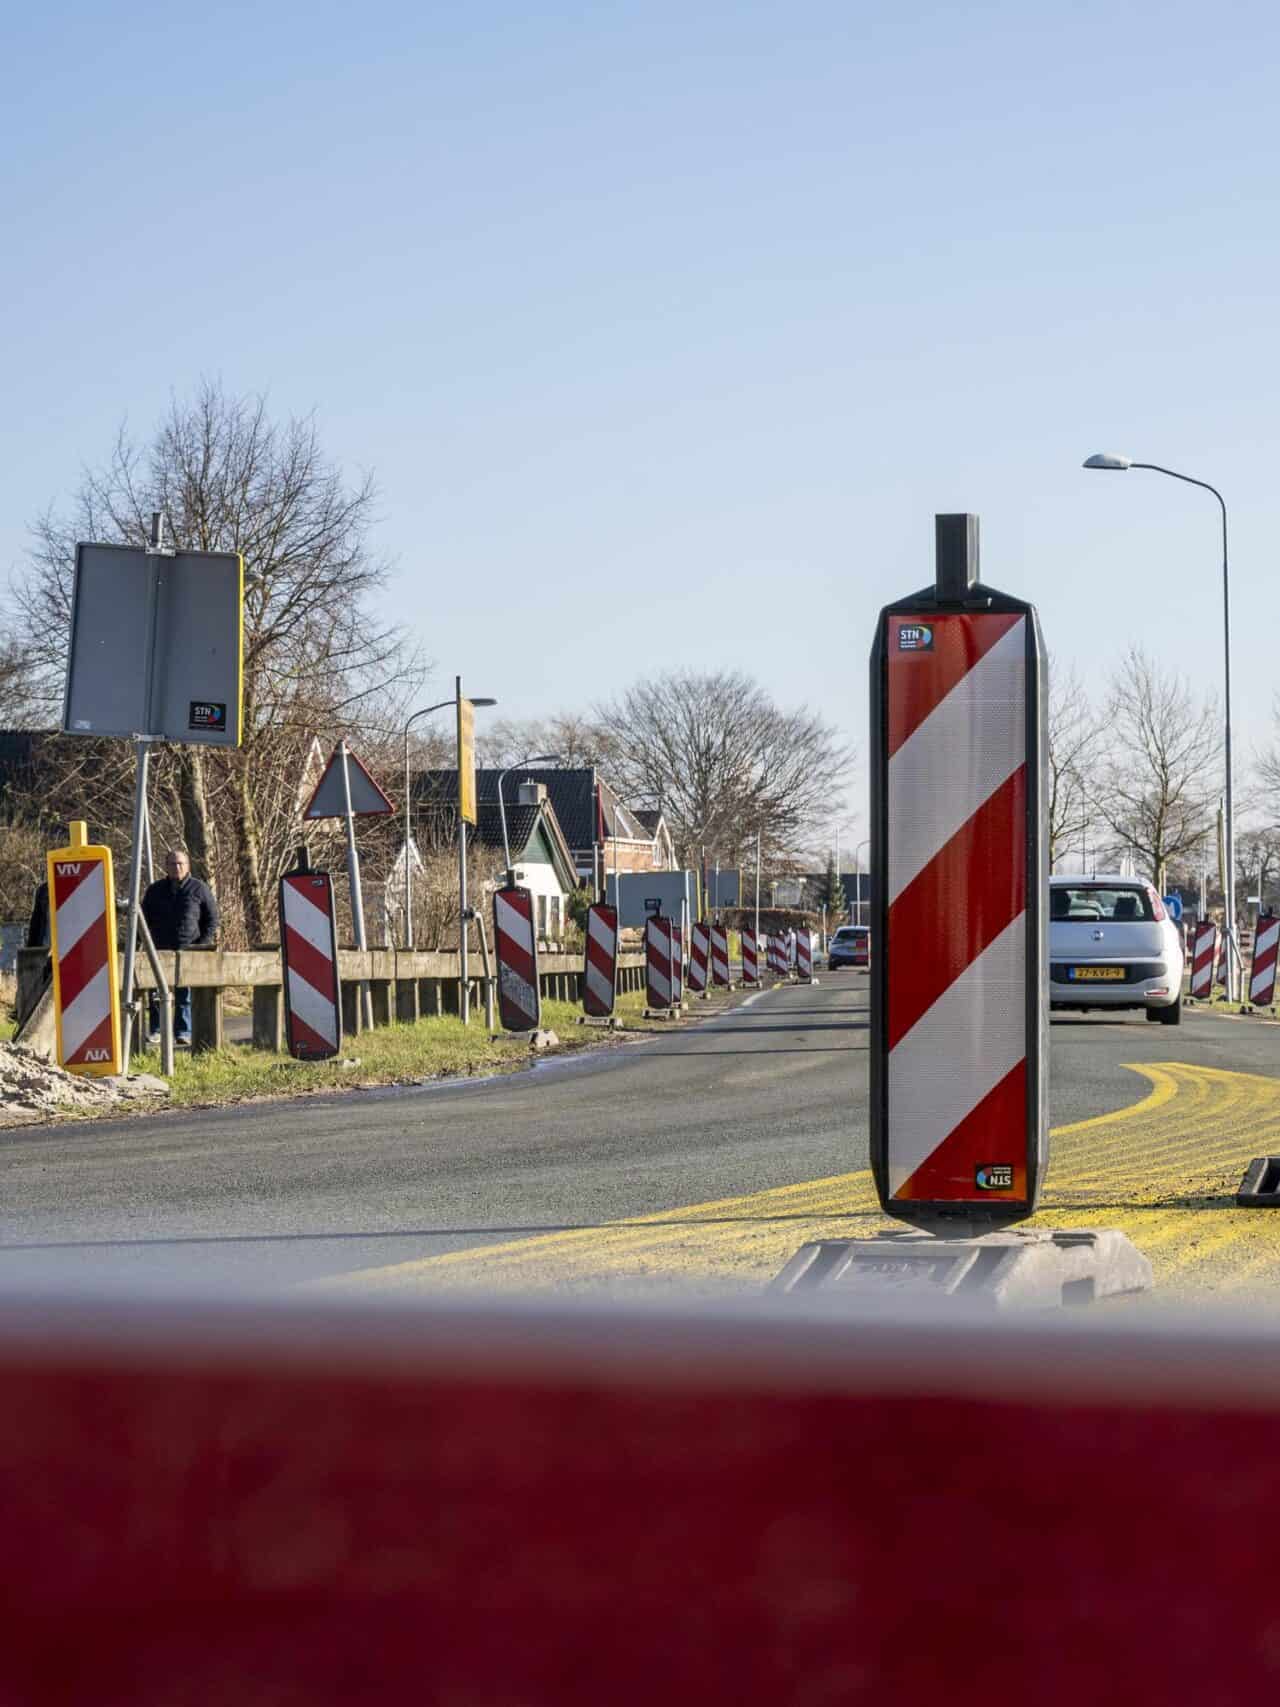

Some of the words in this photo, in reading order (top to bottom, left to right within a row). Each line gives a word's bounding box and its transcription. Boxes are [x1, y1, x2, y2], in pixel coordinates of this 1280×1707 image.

[900, 630, 919, 640] STN
[194, 706, 211, 715] STN
[56, 863, 80, 874] VTV
[990, 1175, 1011, 1185] STN
